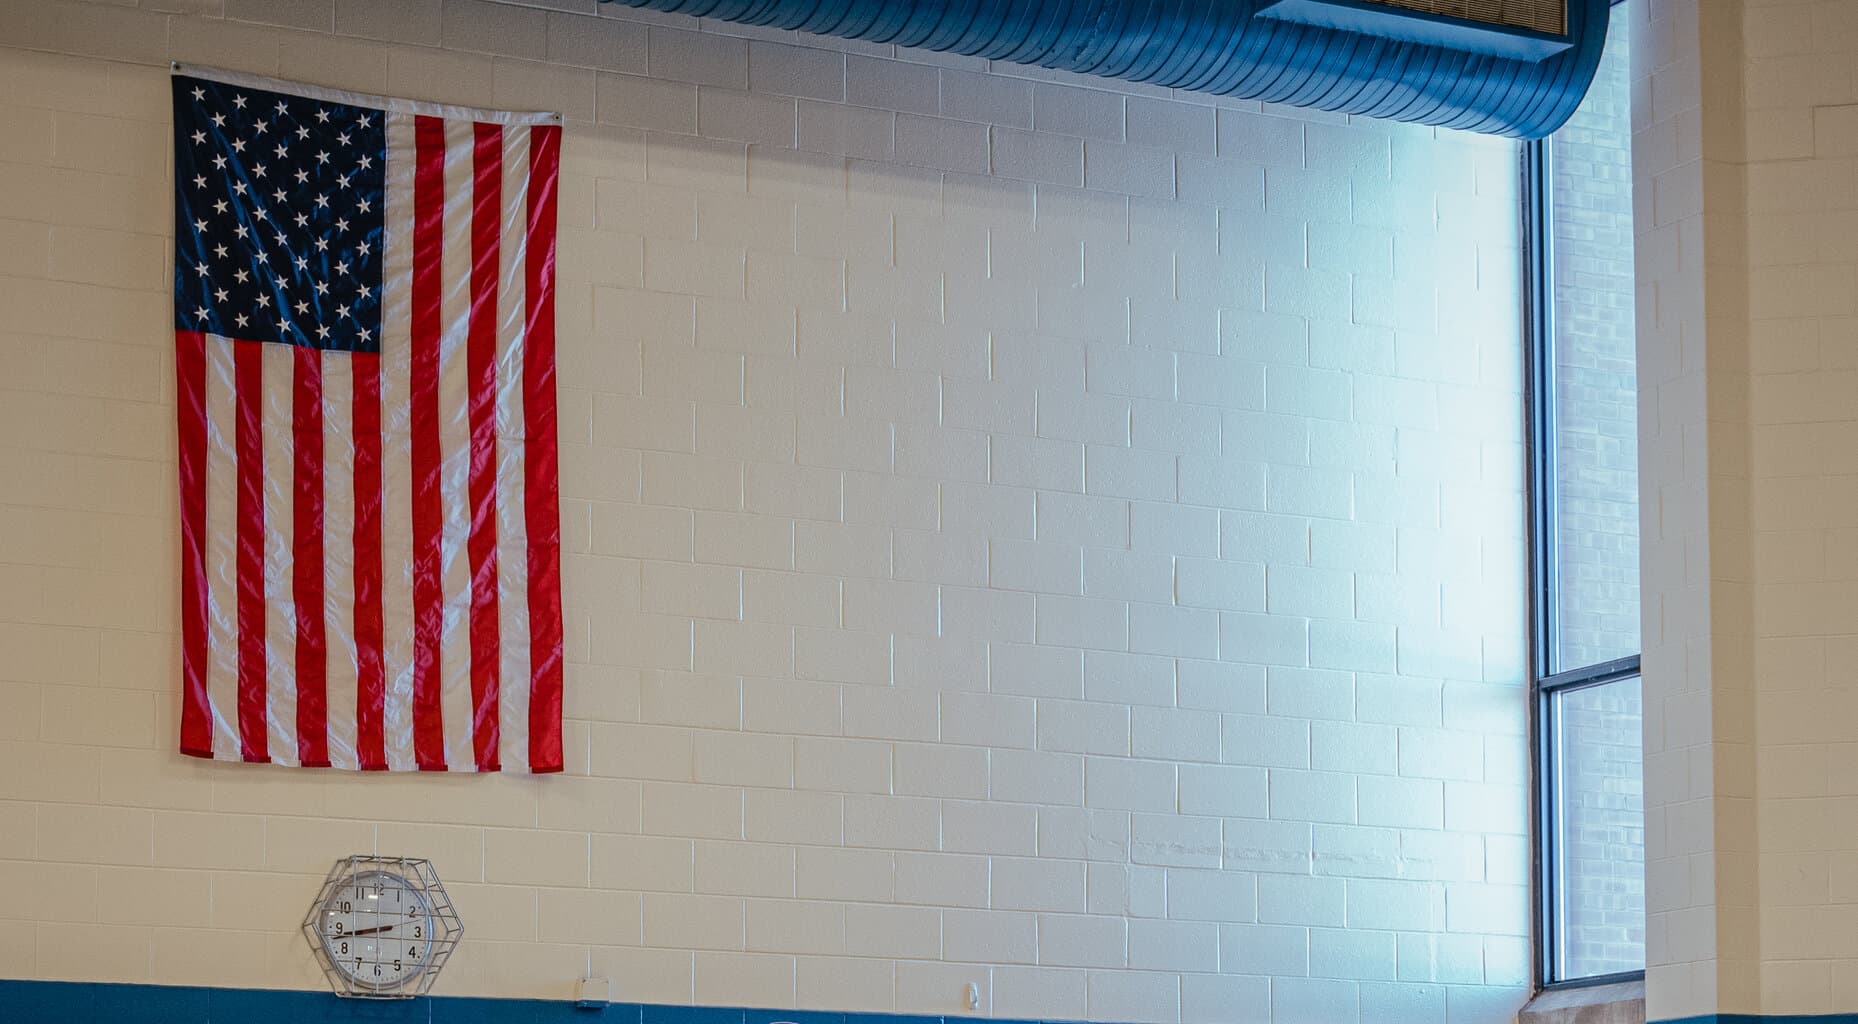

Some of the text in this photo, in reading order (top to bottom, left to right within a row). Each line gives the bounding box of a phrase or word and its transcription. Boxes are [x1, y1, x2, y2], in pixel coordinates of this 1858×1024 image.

[355, 887, 365, 900] 11
[373, 883, 385, 896] 12
[340, 901, 351, 914] 10
[408, 905, 416, 918] 2
[335, 922, 343, 935] 9
[414, 926, 422, 938] 3
[341, 942, 348, 954] 8
[408, 946, 416, 958] 4
[355, 957, 363, 970] 7
[393, 960, 401, 971] 5
[374, 965, 382, 977] 6
